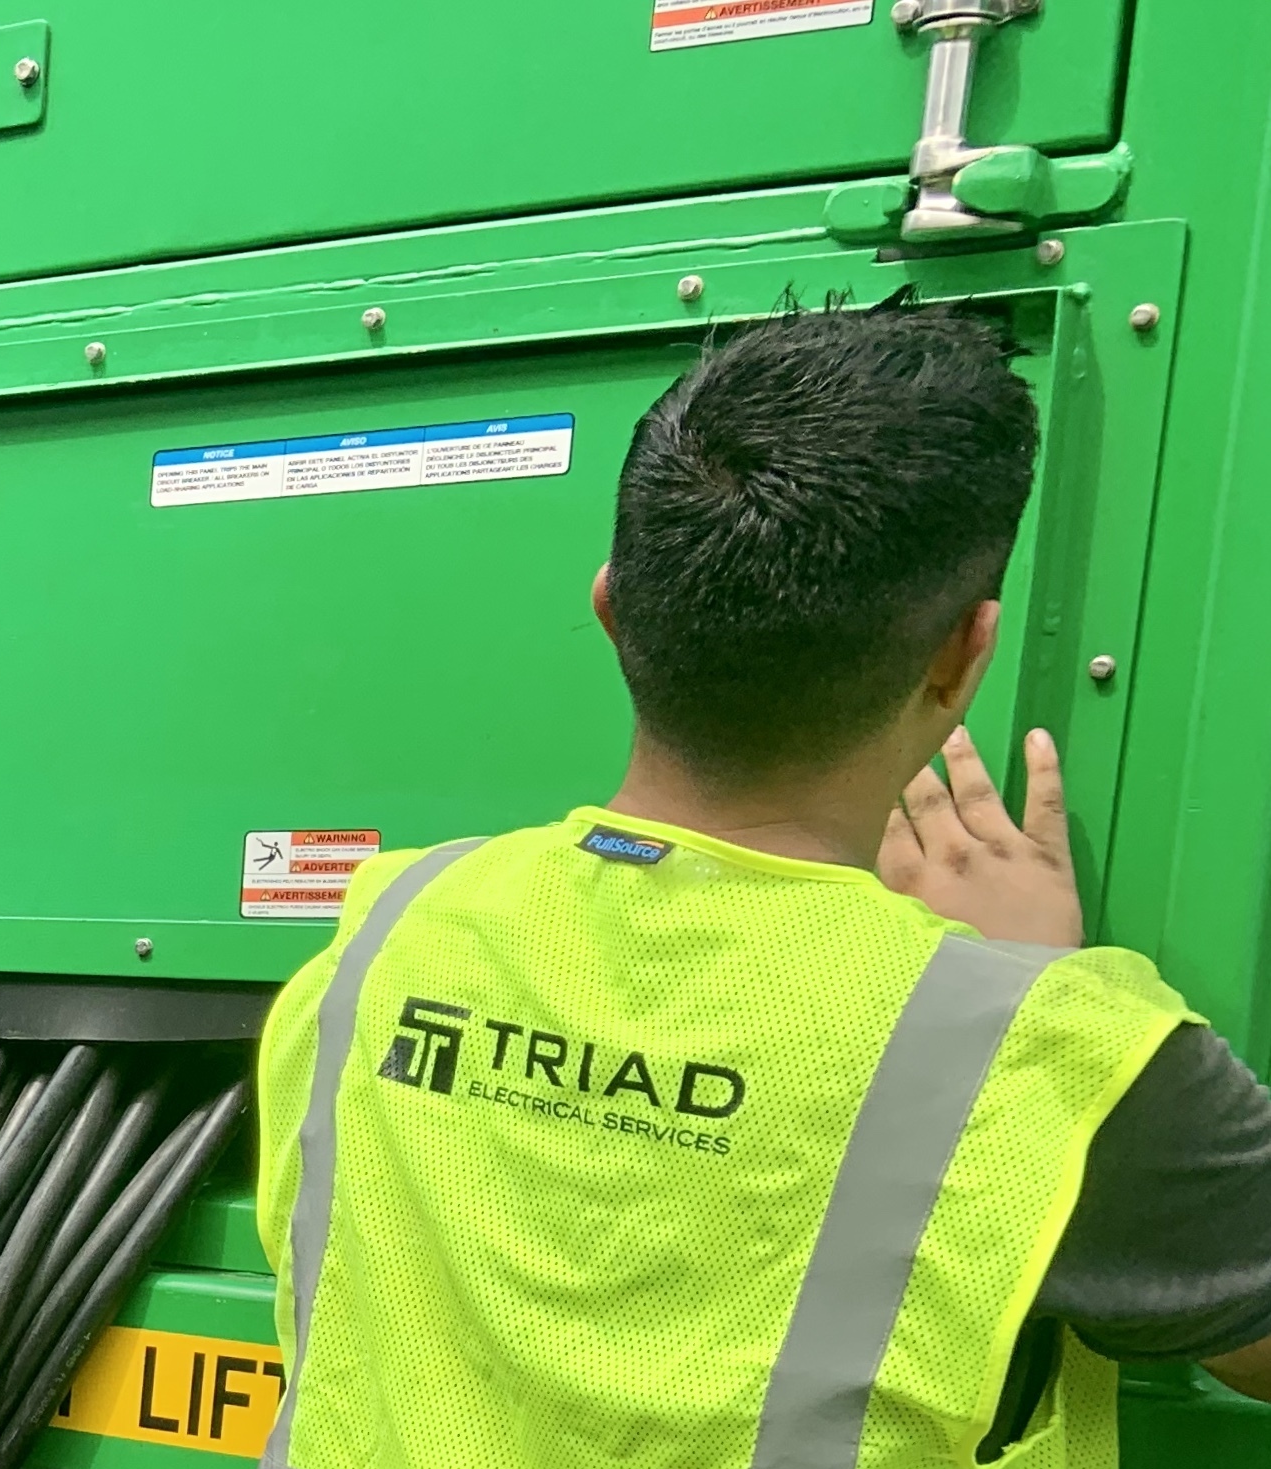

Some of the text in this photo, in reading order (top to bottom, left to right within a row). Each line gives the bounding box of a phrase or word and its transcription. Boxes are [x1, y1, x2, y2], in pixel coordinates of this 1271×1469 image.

[486, 423, 508, 433] AVIS
[340, 436, 367, 446] AVISO
[203, 449, 235, 459] NOTICE
[316, 833, 366, 843] WARNING
[587, 834, 661, 858] FullSource
[303, 862, 356, 872] ADVERTEN
[273, 890, 344, 900] AVERTISSEME
[485, 1018, 747, 1119] TRIAD
[468, 1080, 732, 1156] ELECTRICAL SERVICES
